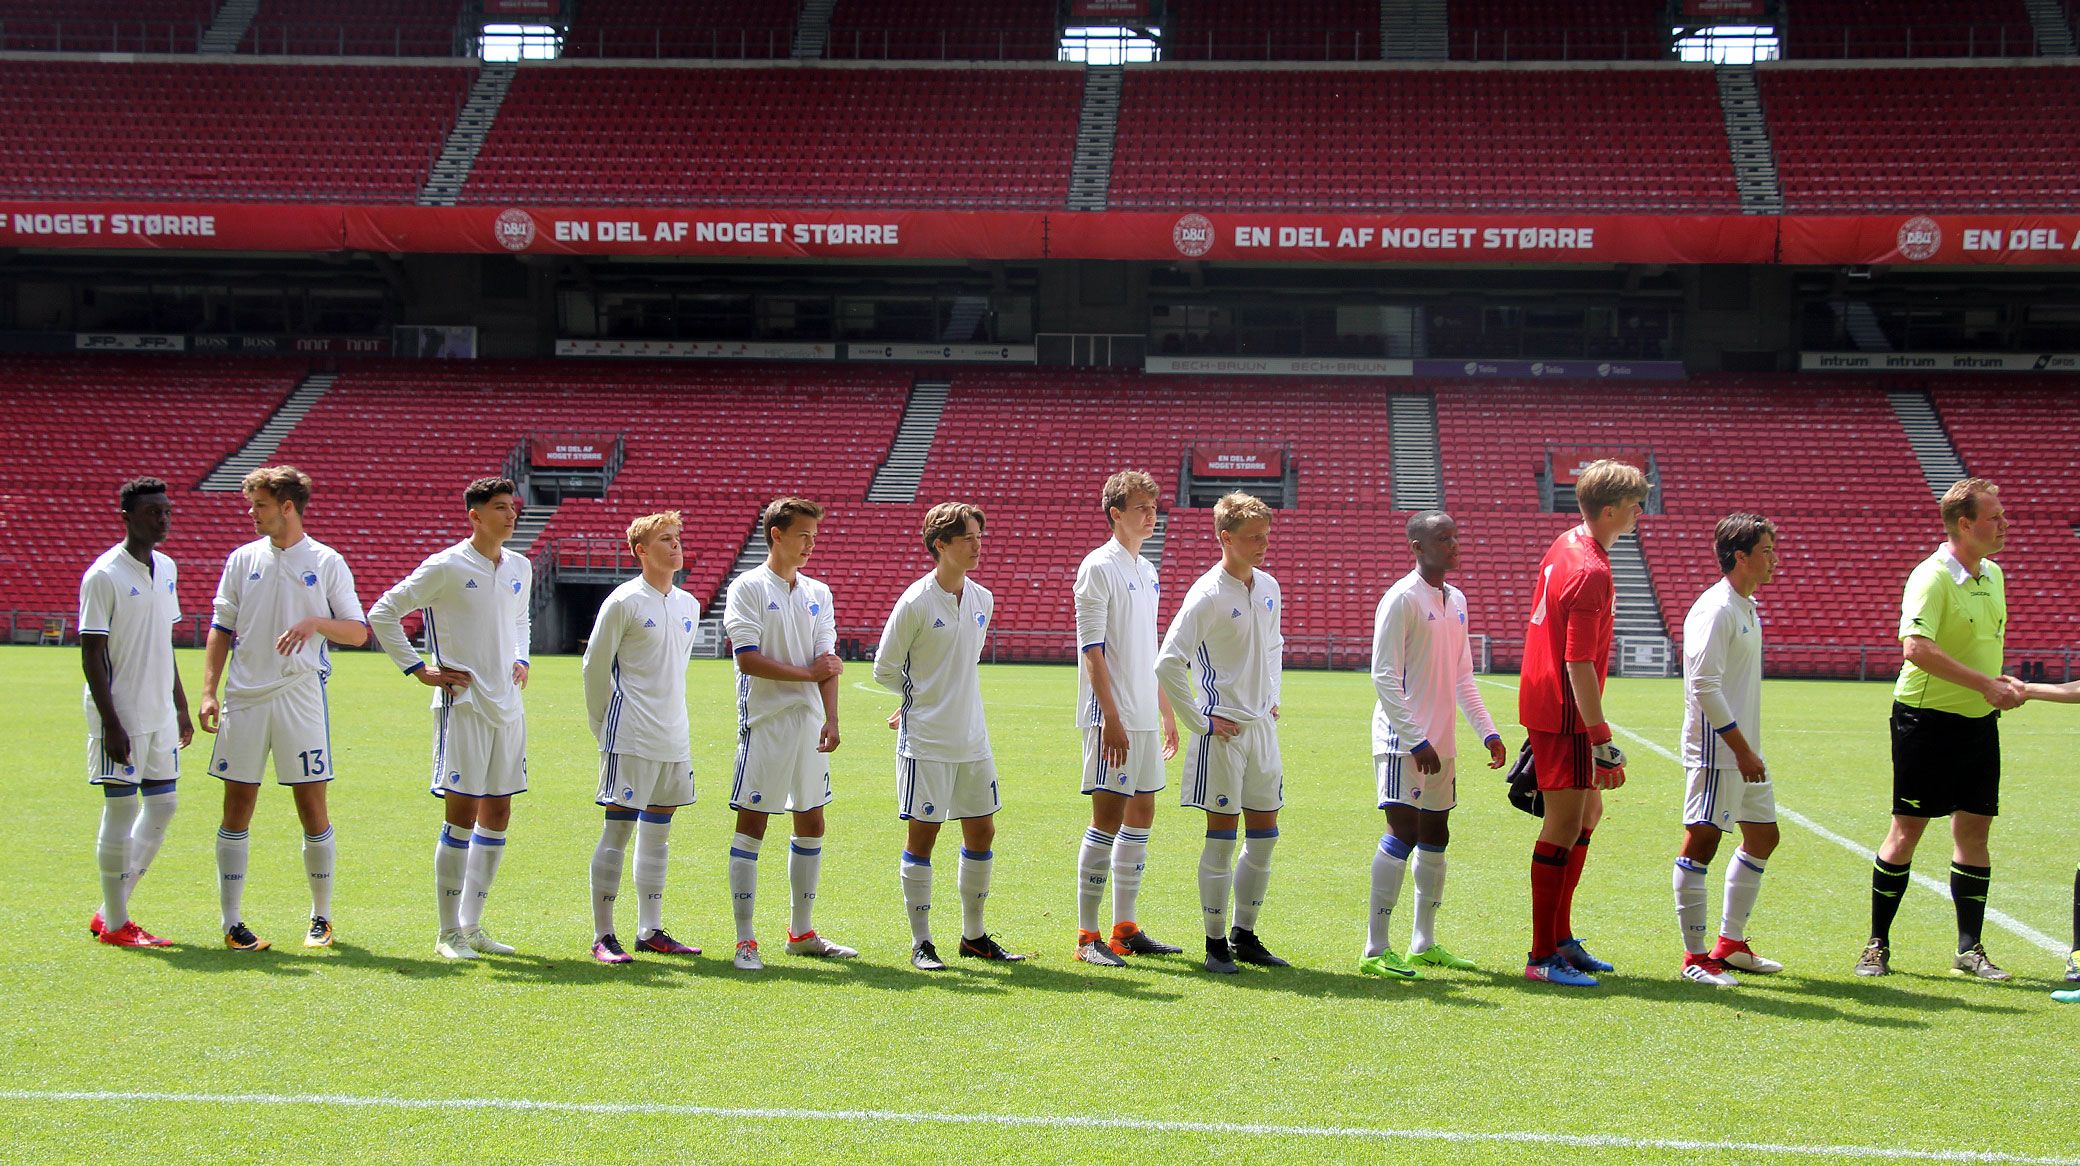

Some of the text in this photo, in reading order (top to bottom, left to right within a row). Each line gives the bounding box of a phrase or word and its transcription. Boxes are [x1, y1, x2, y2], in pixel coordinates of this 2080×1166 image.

[15, 214, 104, 234] NOGET
[111, 214, 215, 236] STØRRE
[555, 222, 590, 242] EN
[597, 222, 647, 242] DEL
[654, 222, 689, 242] AF
[696, 222, 787, 243] NOGET
[794, 223, 899, 245] STØRRE
[1235, 226, 1271, 247] EN
[1278, 227, 1330, 248] DEL
[1337, 227, 1375, 248] AF
[1382, 227, 1477, 248] NOGET
[1484, 227, 1594, 249] STØRRE
[1963, 229, 2001, 250] EN
[2009, 229, 2064, 250] DEL
[195, 336, 228, 347] BOSS
[243, 336, 276, 347] BOSS
[1171, 360, 1267, 371] BECH-BRUUN
[1820, 355, 1869, 367] intrum
[1886, 355, 1935, 367] intrum
[1953, 355, 2003, 367] intrum
[547, 452, 571, 460] NOGET
[298, 749, 325, 776] 13
[224, 873, 243, 881] KBH
